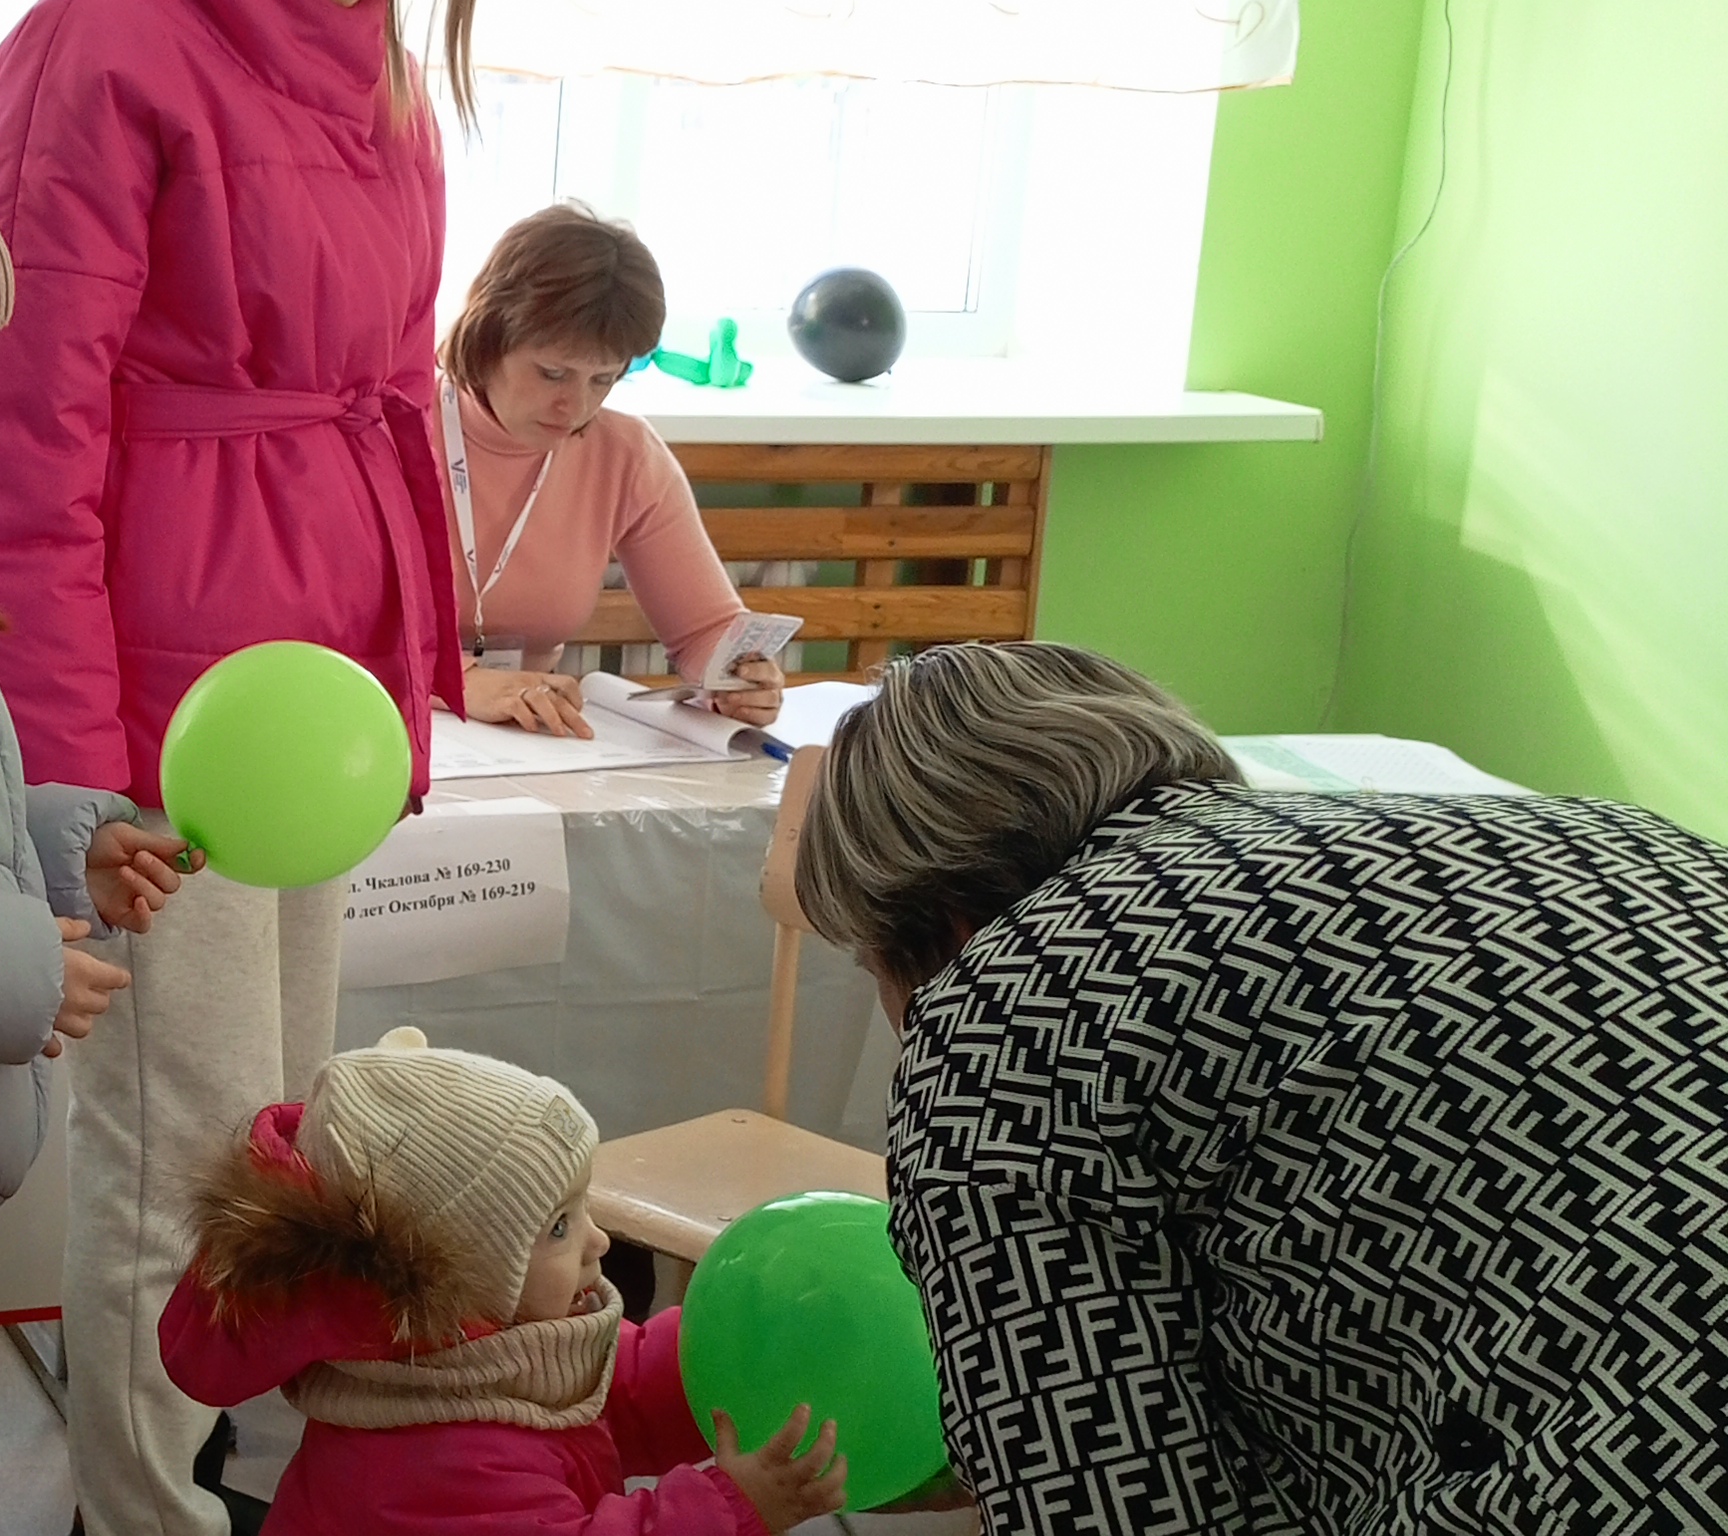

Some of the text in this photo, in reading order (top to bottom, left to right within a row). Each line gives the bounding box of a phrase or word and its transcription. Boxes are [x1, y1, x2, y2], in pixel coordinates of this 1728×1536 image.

[347, 858, 511, 894] л. Чкалова № 169-230
[358, 904, 386, 919] лет
[388, 893, 456, 912] Октября
[459, 889, 477, 905] №
[481, 880, 536, 902] 169-219
